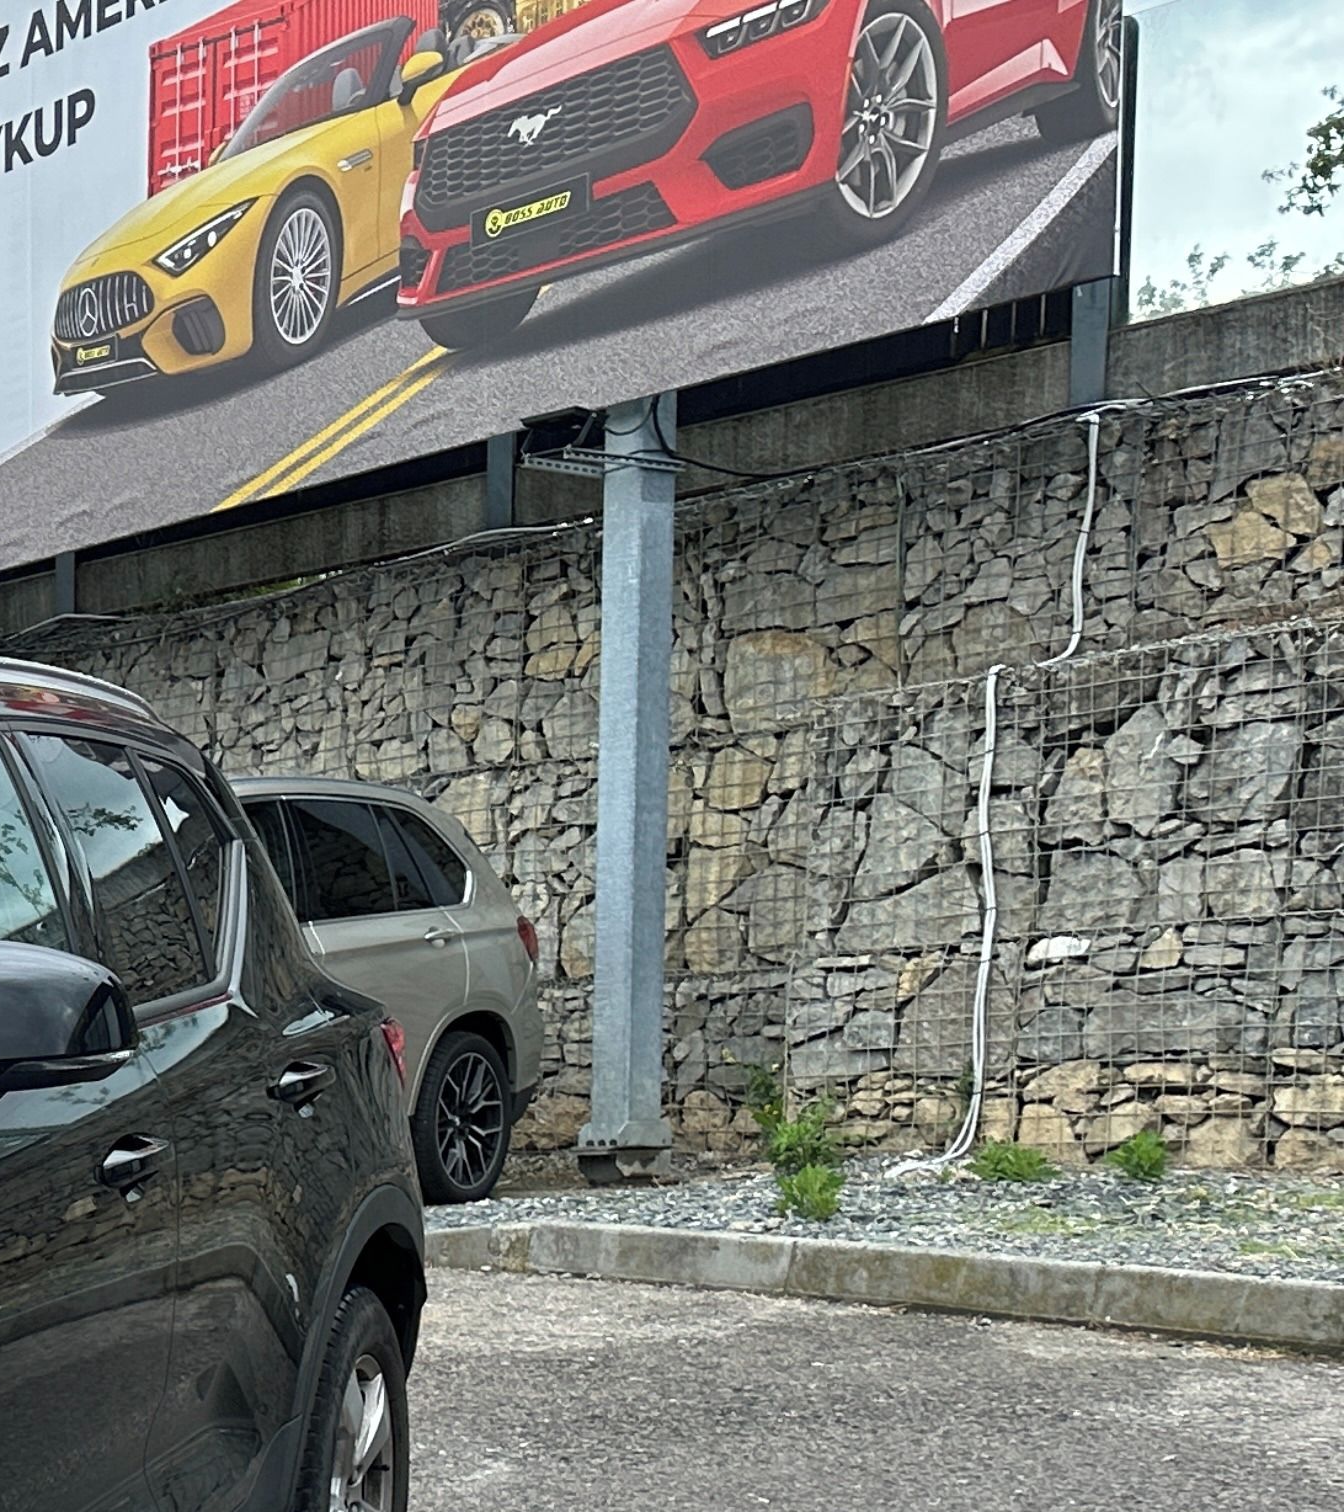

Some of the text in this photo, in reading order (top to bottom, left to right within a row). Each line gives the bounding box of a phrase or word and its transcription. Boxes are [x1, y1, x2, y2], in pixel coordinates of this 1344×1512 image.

[20, 0, 169, 69] AME
[504, 194, 568, 225] BOSS AUTO
